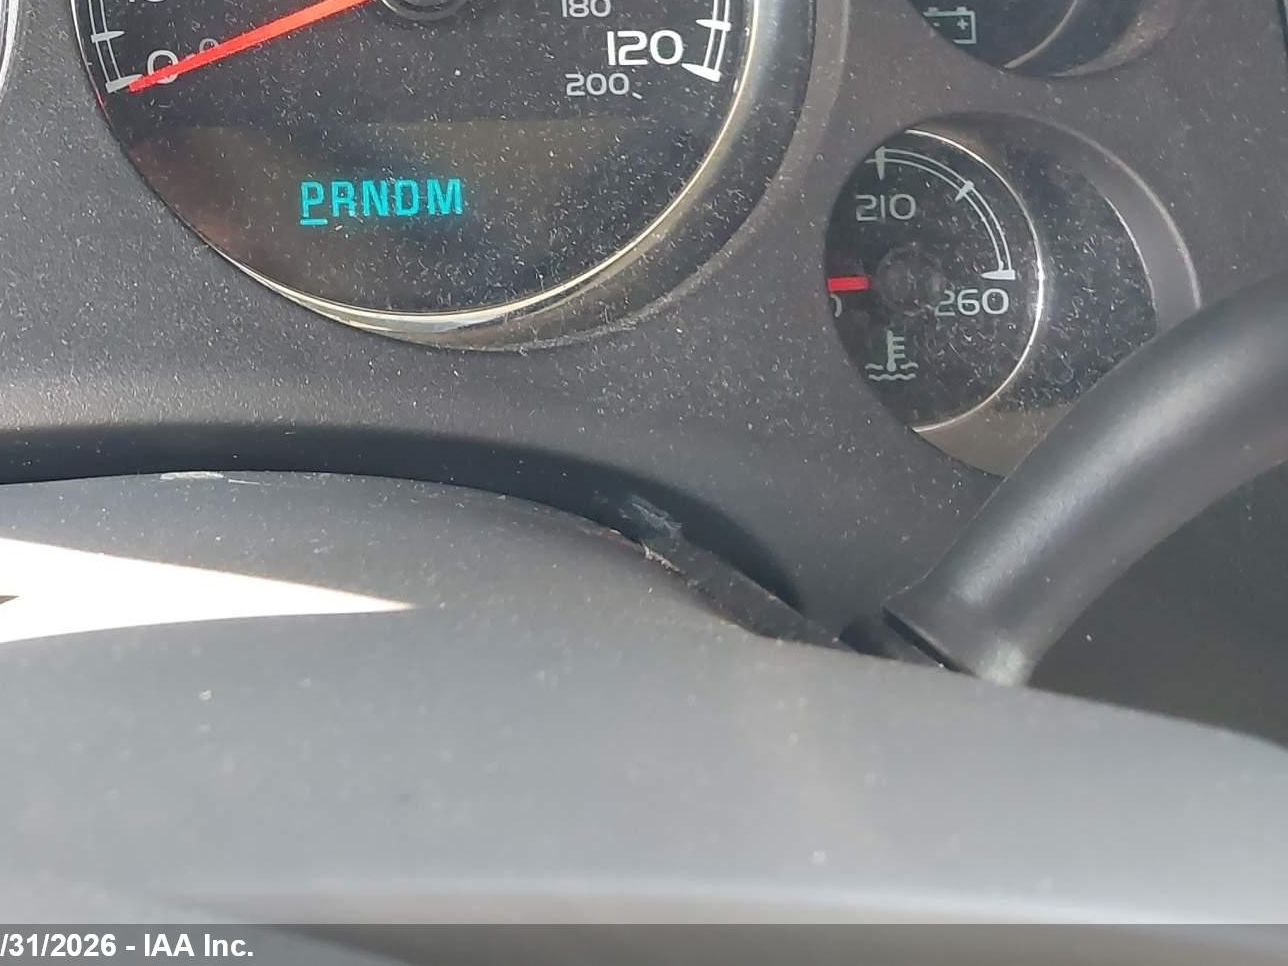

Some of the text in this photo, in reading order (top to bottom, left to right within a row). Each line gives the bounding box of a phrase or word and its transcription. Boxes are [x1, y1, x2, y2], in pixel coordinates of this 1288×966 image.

[607, 30, 684, 66] 120
[147, 49, 179, 84] 0
[566, 73, 629, 97] 200
[299, 178, 463, 219] PRNDM
[855, 193, 917, 222] 210
[933, 287, 1010, 317] 260
